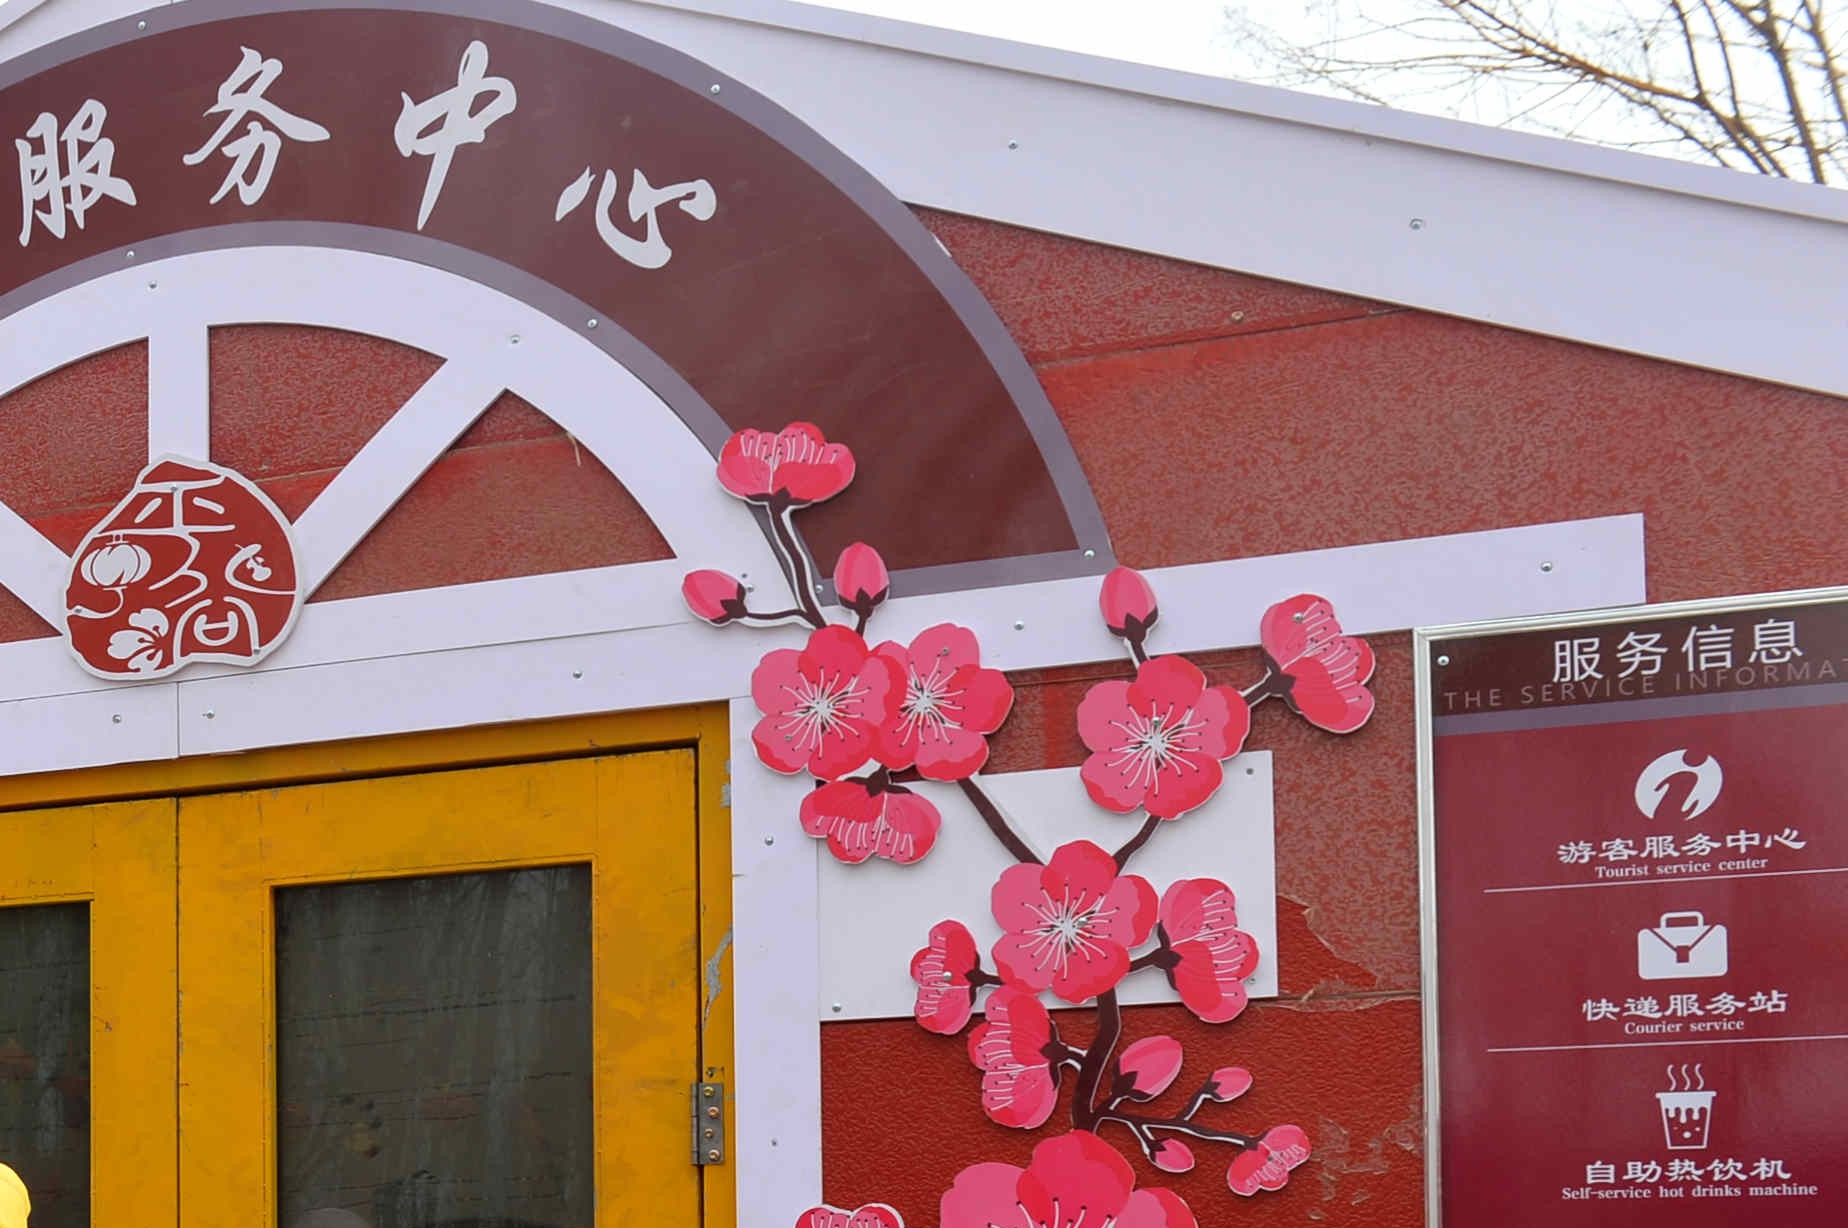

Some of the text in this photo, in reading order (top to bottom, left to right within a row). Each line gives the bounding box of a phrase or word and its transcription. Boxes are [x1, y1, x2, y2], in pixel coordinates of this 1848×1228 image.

[1552, 617, 1804, 684] 服务信息
[1443, 658, 1848, 711] THE SERVICE INFORMA
[1556, 828, 1807, 864] 游客服务中心
[1595, 857, 1769, 880] Tourist service center
[1582, 989, 1789, 1023] 快递服务站
[1624, 1018, 1745, 1035] Courier service
[1585, 1157, 1793, 1185] 自助热饮机
[1562, 1181, 1818, 1201] Self-service hot drinks machine
